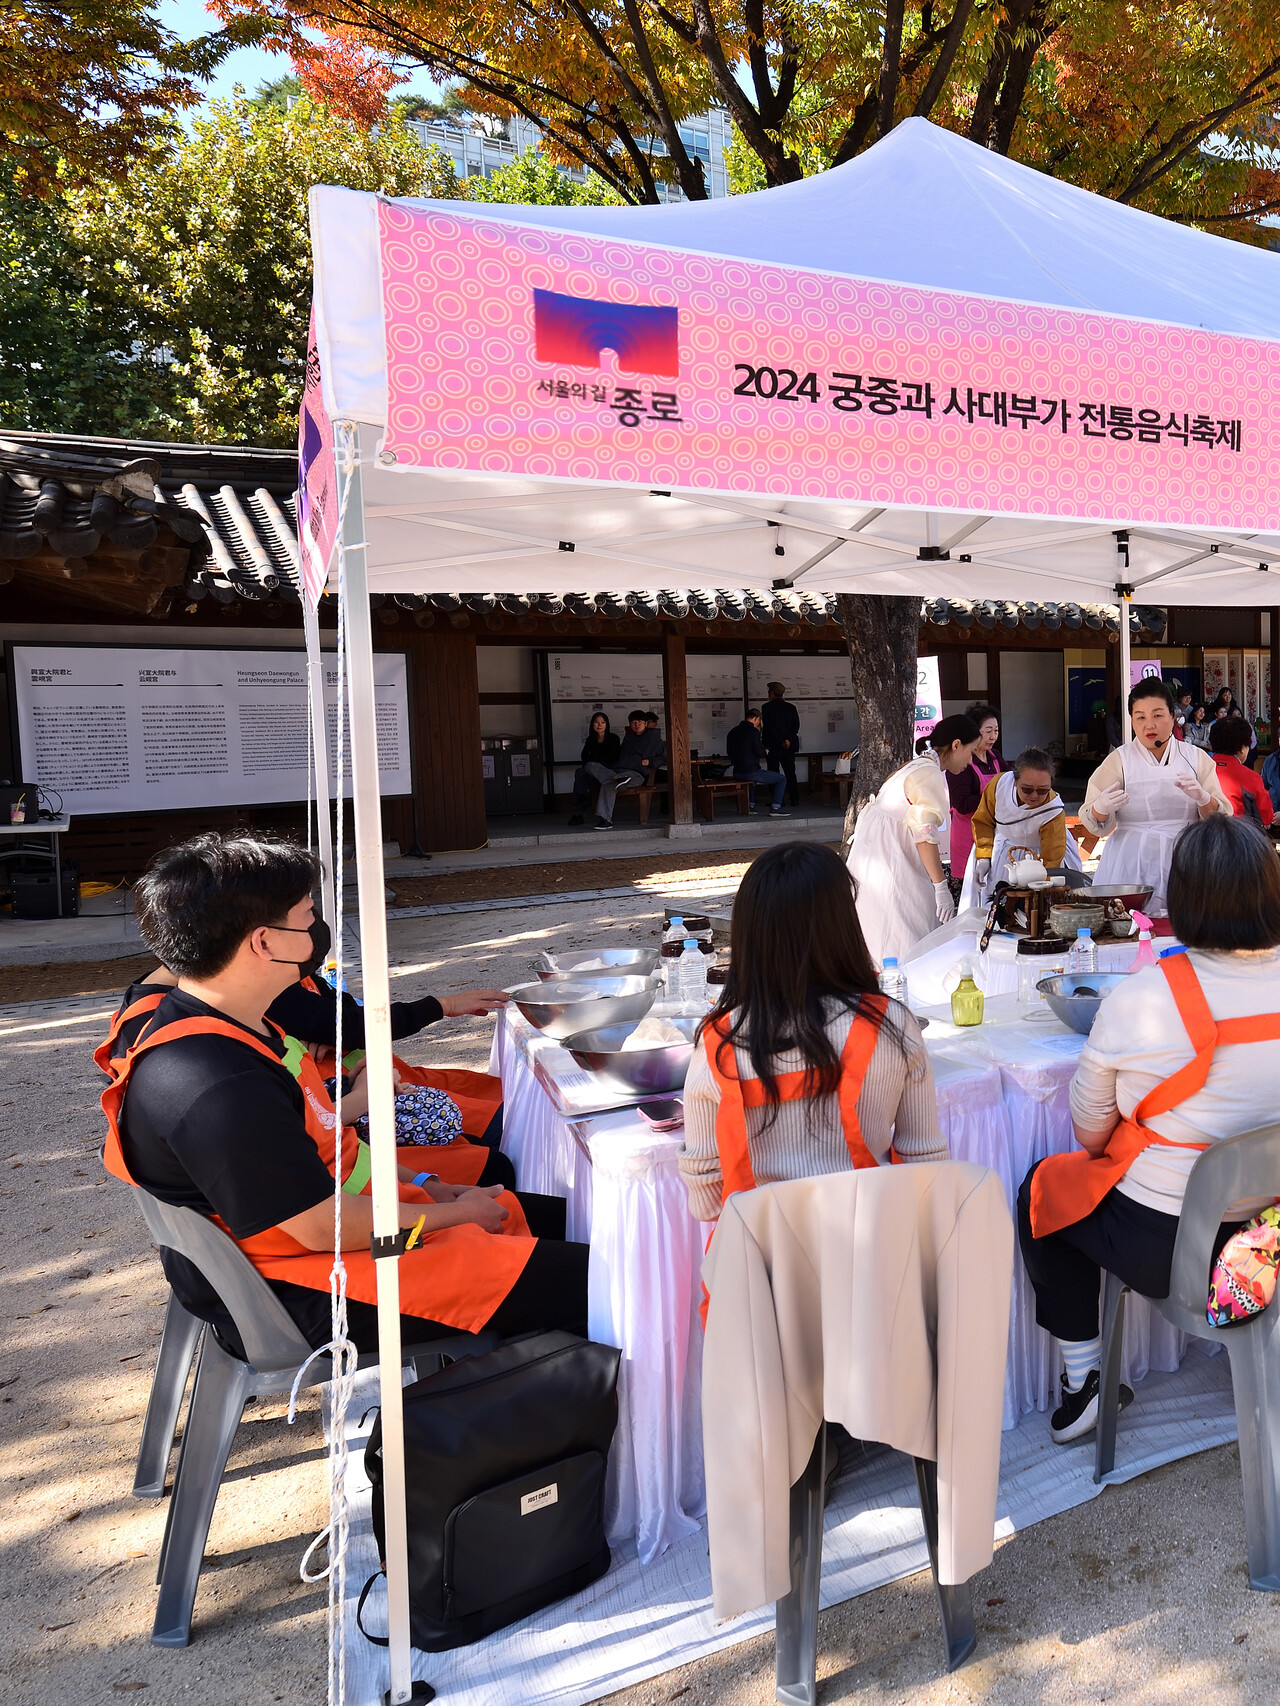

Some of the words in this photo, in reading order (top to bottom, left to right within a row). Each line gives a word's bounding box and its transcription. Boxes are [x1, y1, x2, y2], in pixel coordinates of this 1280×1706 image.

[536, 378, 589, 400] 서울의
[591, 385, 607, 403] 길
[610, 387, 683, 427] 종로
[733, 364, 820, 403] 2024
[827, 371, 935, 419] 궁중과
[942, 387, 1071, 433] 사대부가
[1078, 402, 1242, 452] 전통음식축제
[1145, 668, 1155, 678] 11
